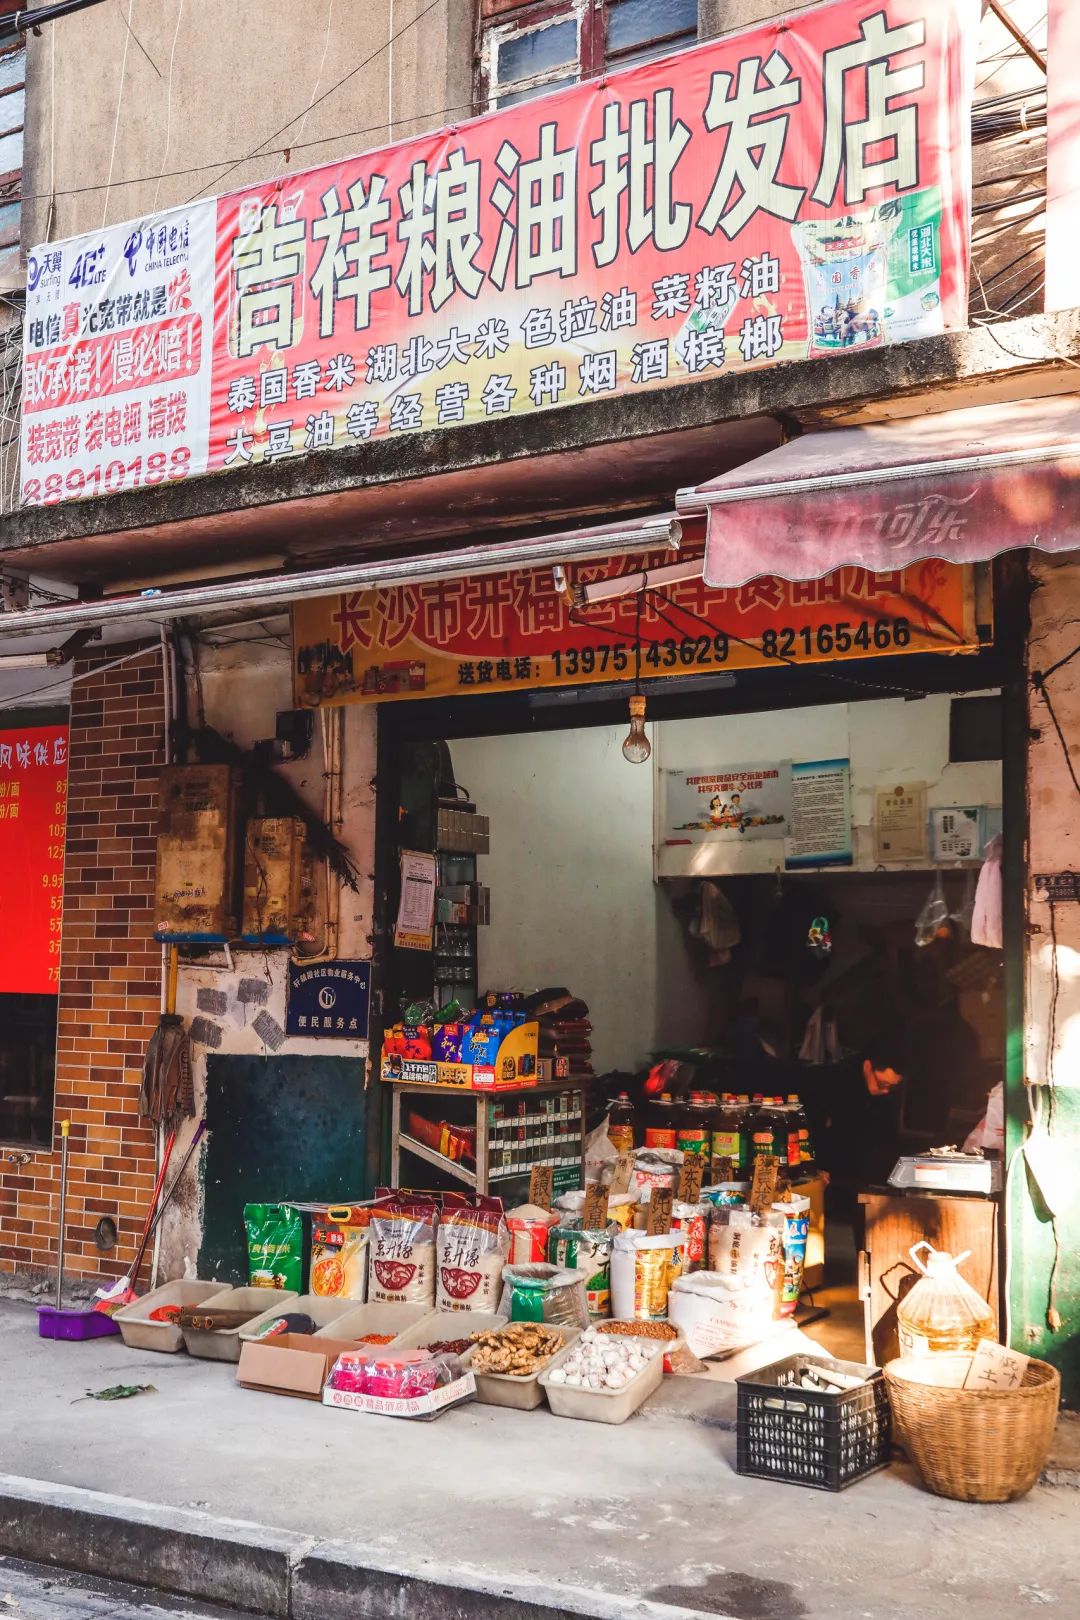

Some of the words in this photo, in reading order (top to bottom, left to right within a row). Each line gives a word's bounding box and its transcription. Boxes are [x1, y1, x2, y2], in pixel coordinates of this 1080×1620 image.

[231, 9, 926, 358] 吉祥粮油批发店
[43, 250, 63, 274] 天翼
[145, 220, 190, 258] 中国电信
[227, 354, 356, 414] 泰国香米
[365, 319, 510, 383] 湖北大米
[520, 287, 637, 349] 色拉油
[652, 252, 780, 321] 菜籽油
[27, 415, 81, 467] 装宽带
[85, 400, 142, 454] 装电视
[148, 390, 188, 440] 请拨
[23, 446, 192, 506] 88910188
[551, 632, 729, 678] 13975143629
[761, 616, 912, 658] 82165466
[298, 1015, 359, 1030] 便民服务点
